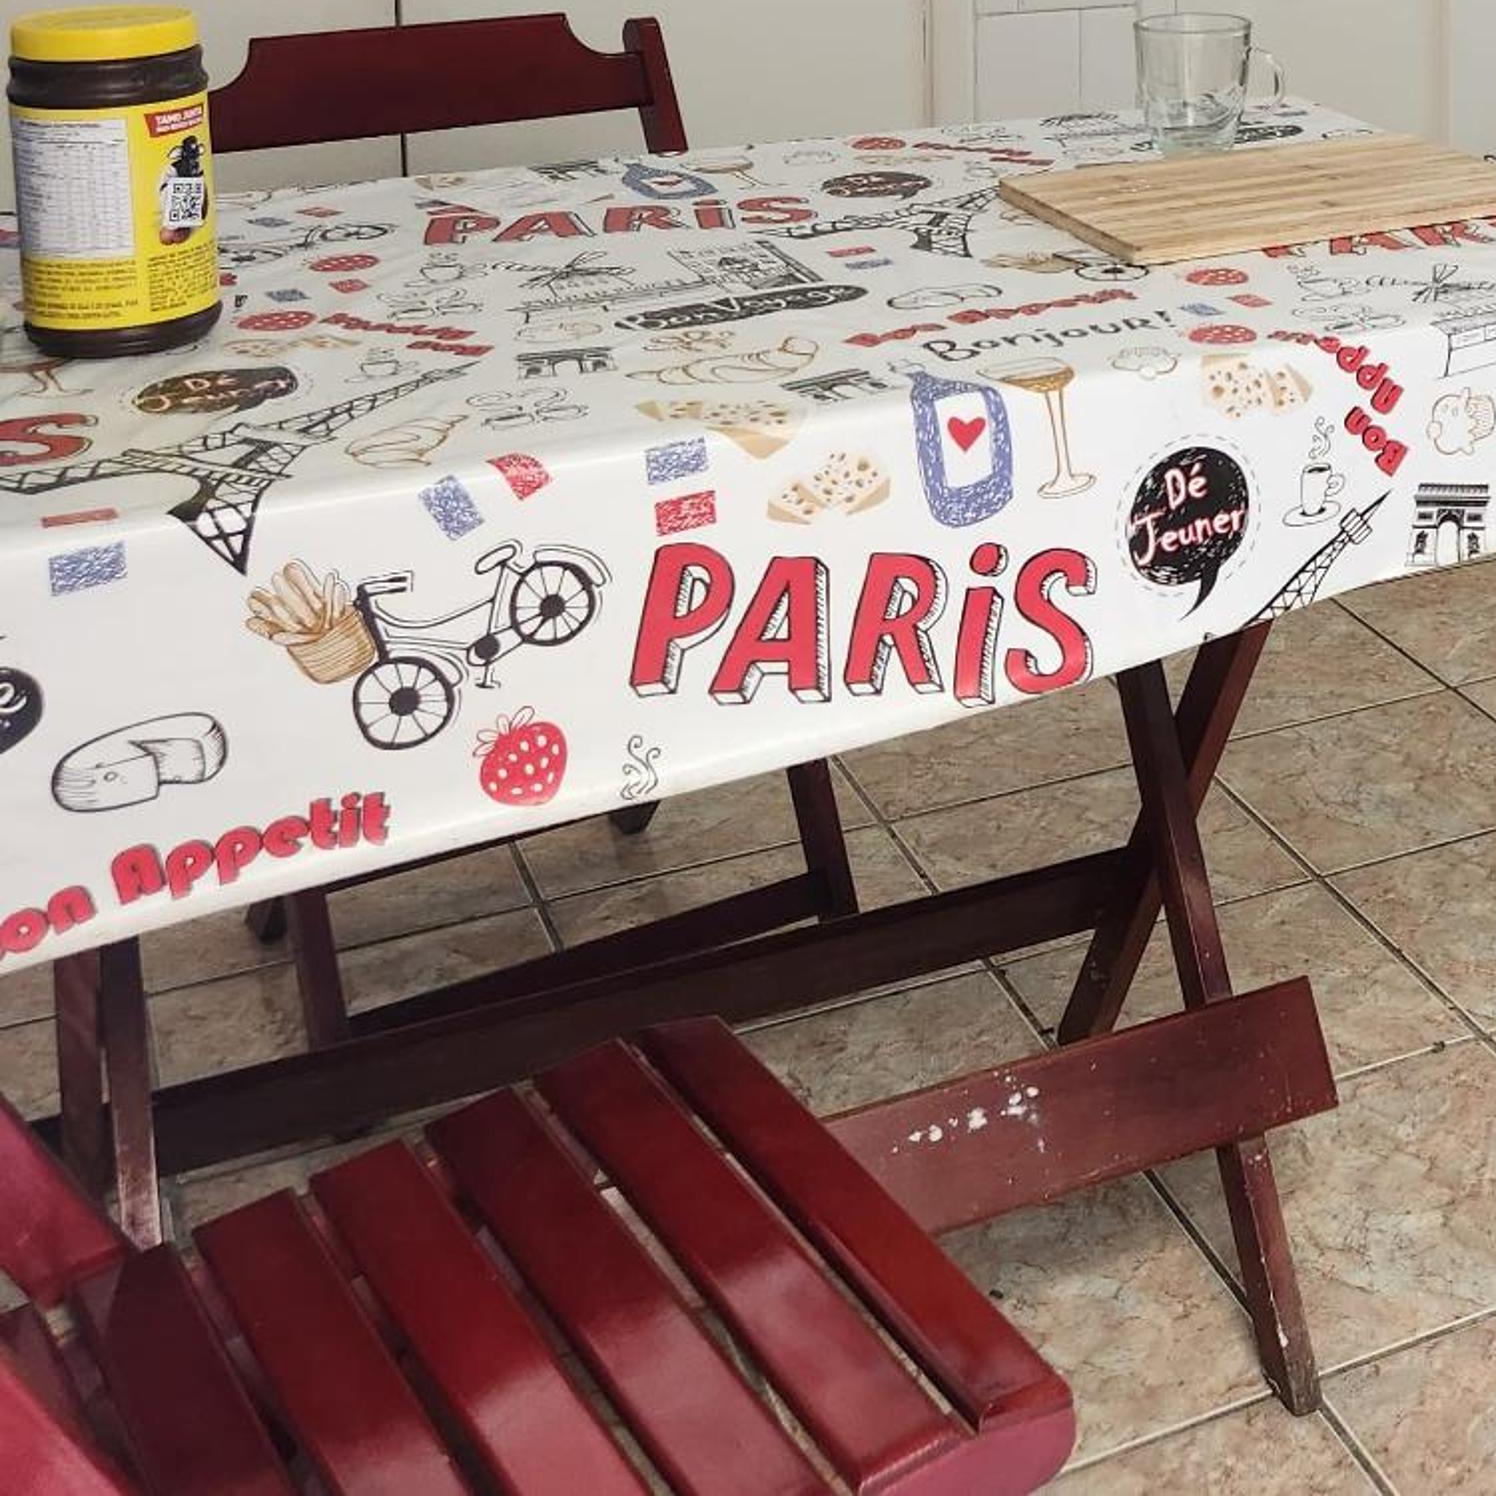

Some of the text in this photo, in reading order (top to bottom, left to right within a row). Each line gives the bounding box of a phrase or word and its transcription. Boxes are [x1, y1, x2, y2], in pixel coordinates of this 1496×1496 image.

[1164, 462, 1208, 510] Dé
[1128, 502, 1246, 567] Jeuner
[0, 791, 392, 954] on Appetit
